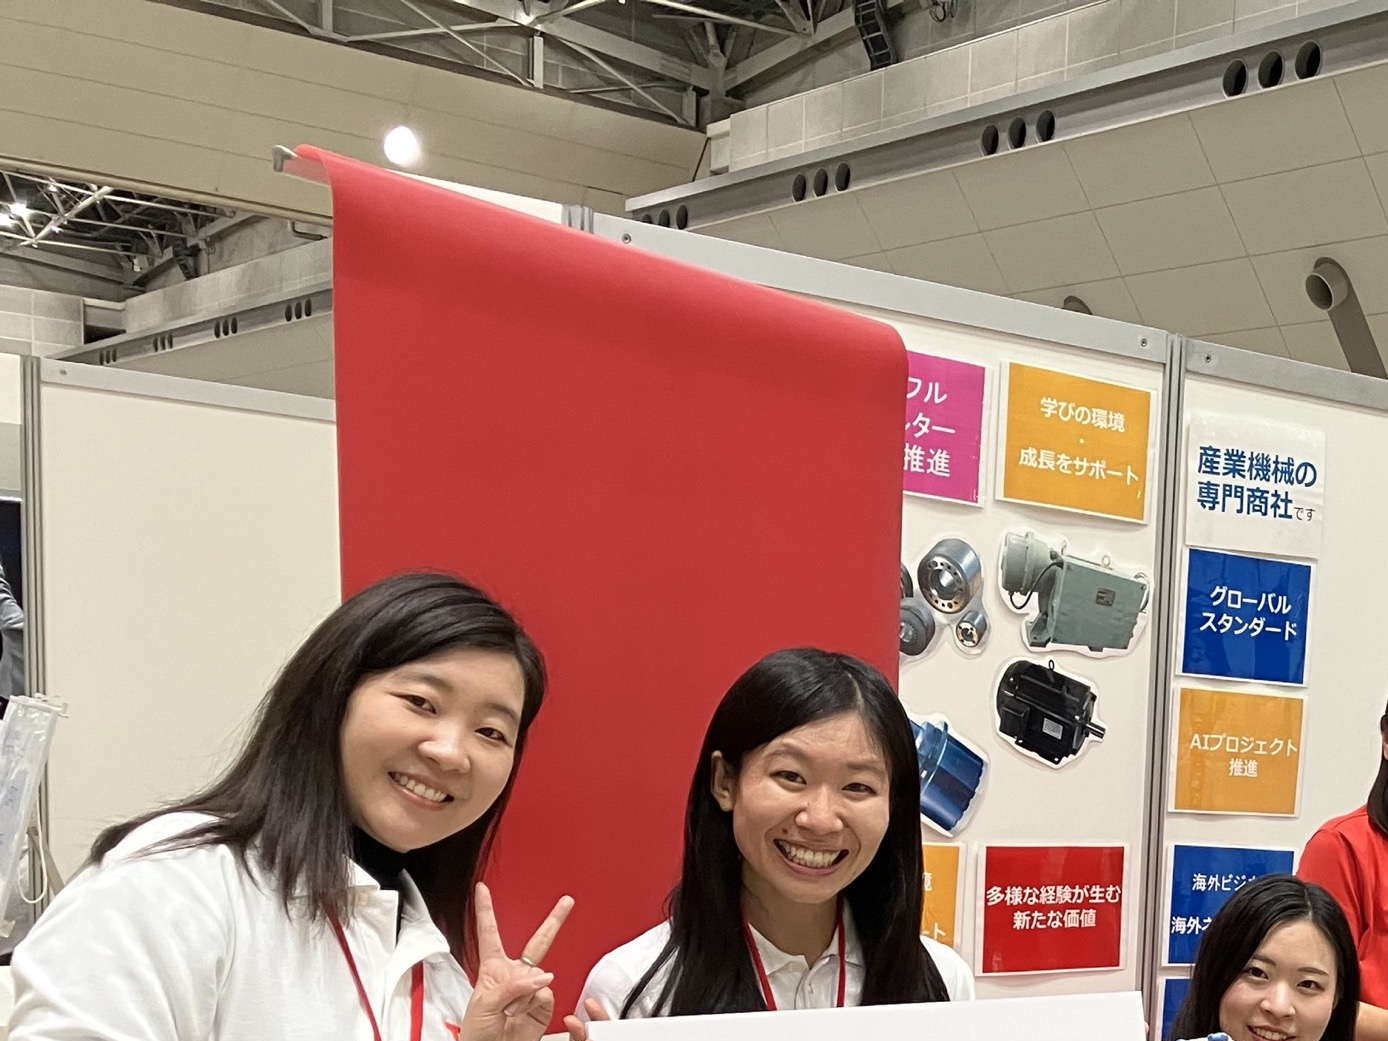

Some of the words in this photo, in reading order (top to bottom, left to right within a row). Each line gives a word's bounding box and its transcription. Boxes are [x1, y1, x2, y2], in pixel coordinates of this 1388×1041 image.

[1039, 397, 1125, 432] 学びの環境
[903, 443, 951, 477] 推進
[1018, 446, 1139, 485] 成長をサポート
[1198, 445, 1317, 488] 産業機械の
[1210, 585, 1292, 615] グローバル
[1200, 612, 1297, 641] スタンダード
[1189, 732, 1298, 757] AIプロジェクト
[1228, 757, 1258, 777] 推進
[986, 885, 1122, 906] 多様な経験が生む
[1012, 908, 1097, 930] 新たな価値
